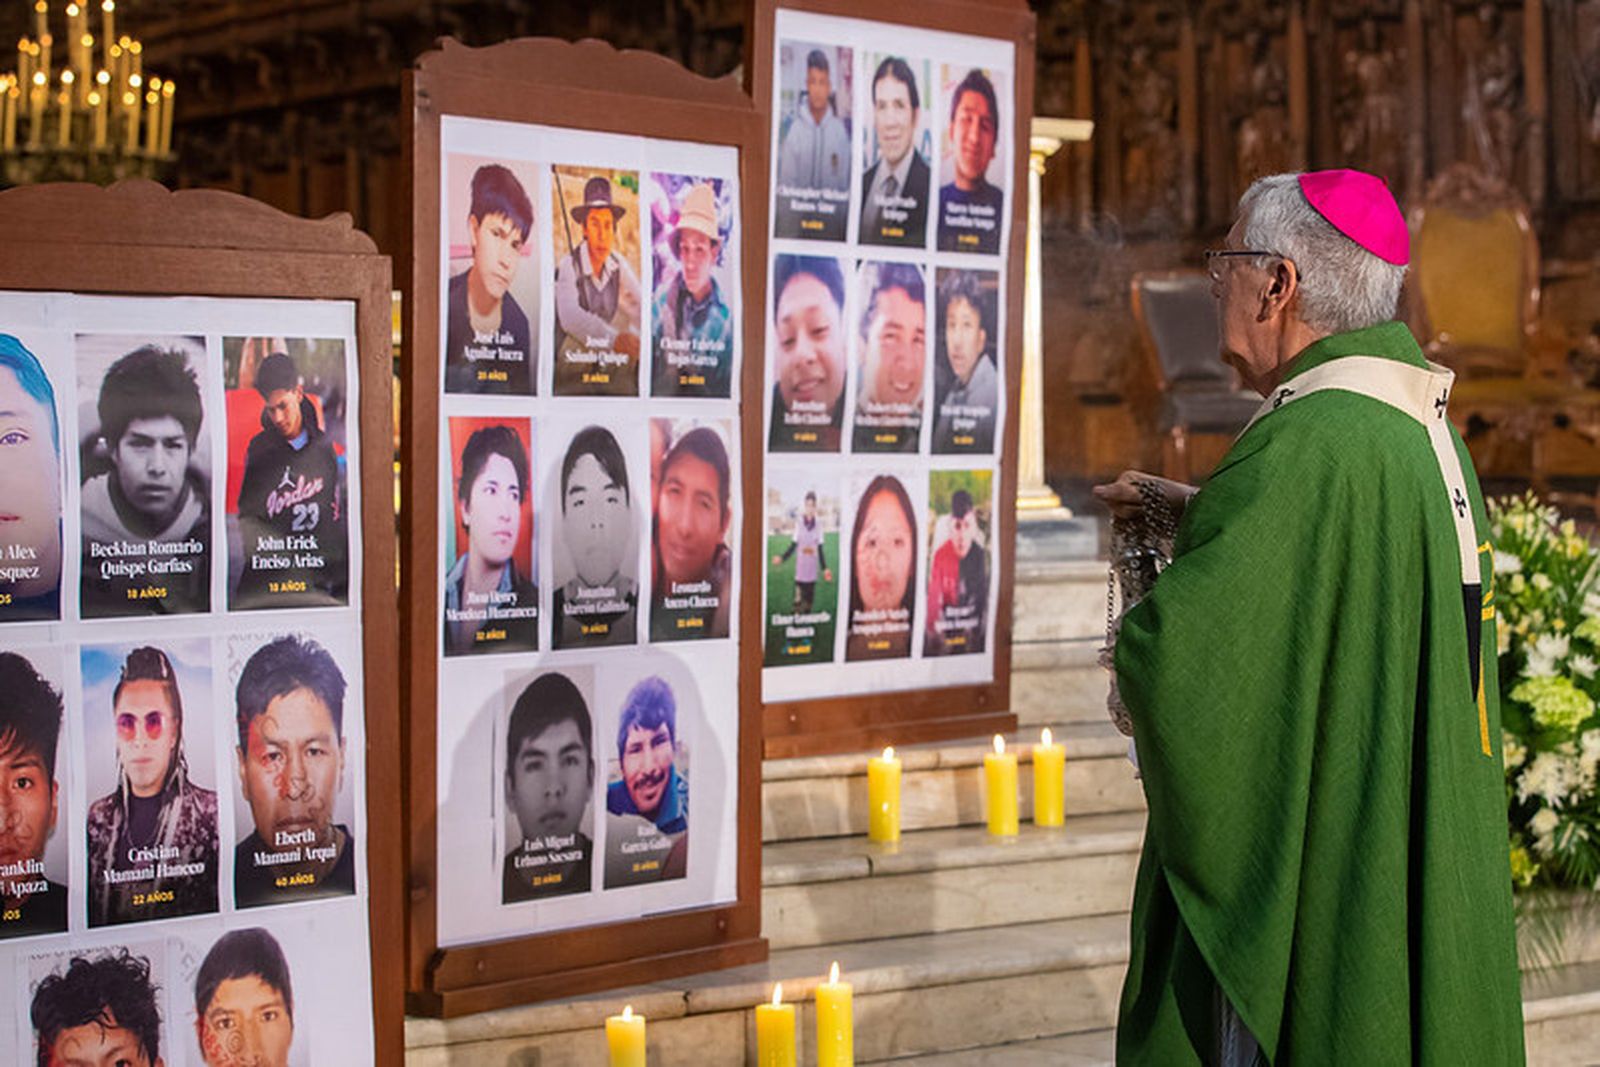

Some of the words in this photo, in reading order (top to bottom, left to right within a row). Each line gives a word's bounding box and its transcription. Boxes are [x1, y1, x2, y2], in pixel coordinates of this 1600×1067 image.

[291, 502, 320, 531] 23
[8, 544, 37, 559] Alex
[91, 541, 147, 557] Beckhan
[148, 539, 203, 555] Romario
[256, 536, 285, 551] John
[286, 535, 319, 550] Erick
[101, 560, 147, 580] Quispe
[147, 557, 192, 574] Garfias
[251, 554, 291, 570] Enciso
[292, 553, 325, 568] Arias
[139, 586, 168, 599] AÑOS
[280, 580, 306, 592] AÑOS
[275, 828, 316, 846] Eberth
[127, 845, 180, 863] Cristian
[253, 849, 302, 866] Mamani
[303, 843, 337, 862] Arqui
[103, 865, 155, 884] Mamani
[288, 873, 316, 886] AÑOS
[7, 880, 49, 898] Apaza
[146, 891, 175, 904] AÑOS
